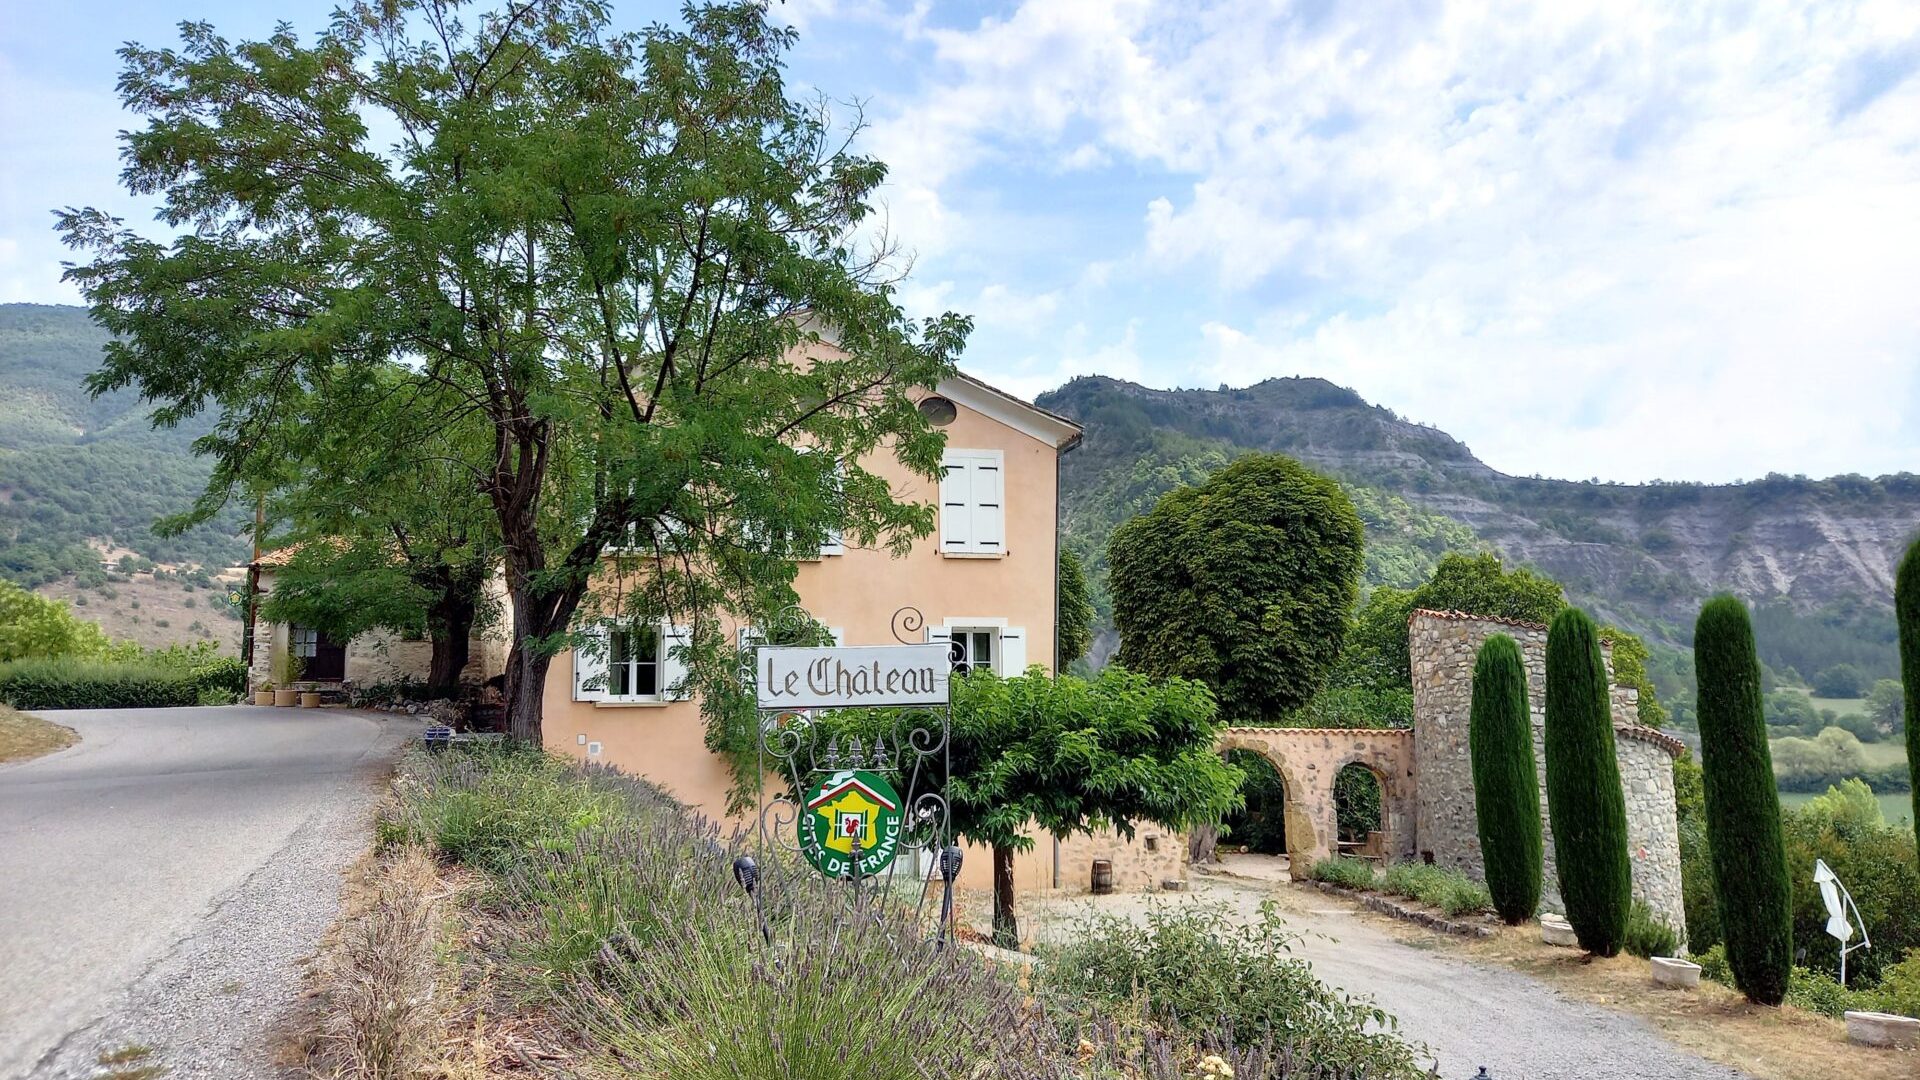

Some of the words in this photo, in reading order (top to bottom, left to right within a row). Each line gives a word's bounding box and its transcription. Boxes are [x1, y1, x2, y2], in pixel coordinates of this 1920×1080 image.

[807, 655, 936, 699] Château
[827, 857, 851, 875] DE
[858, 816, 900, 873] FRANCE
